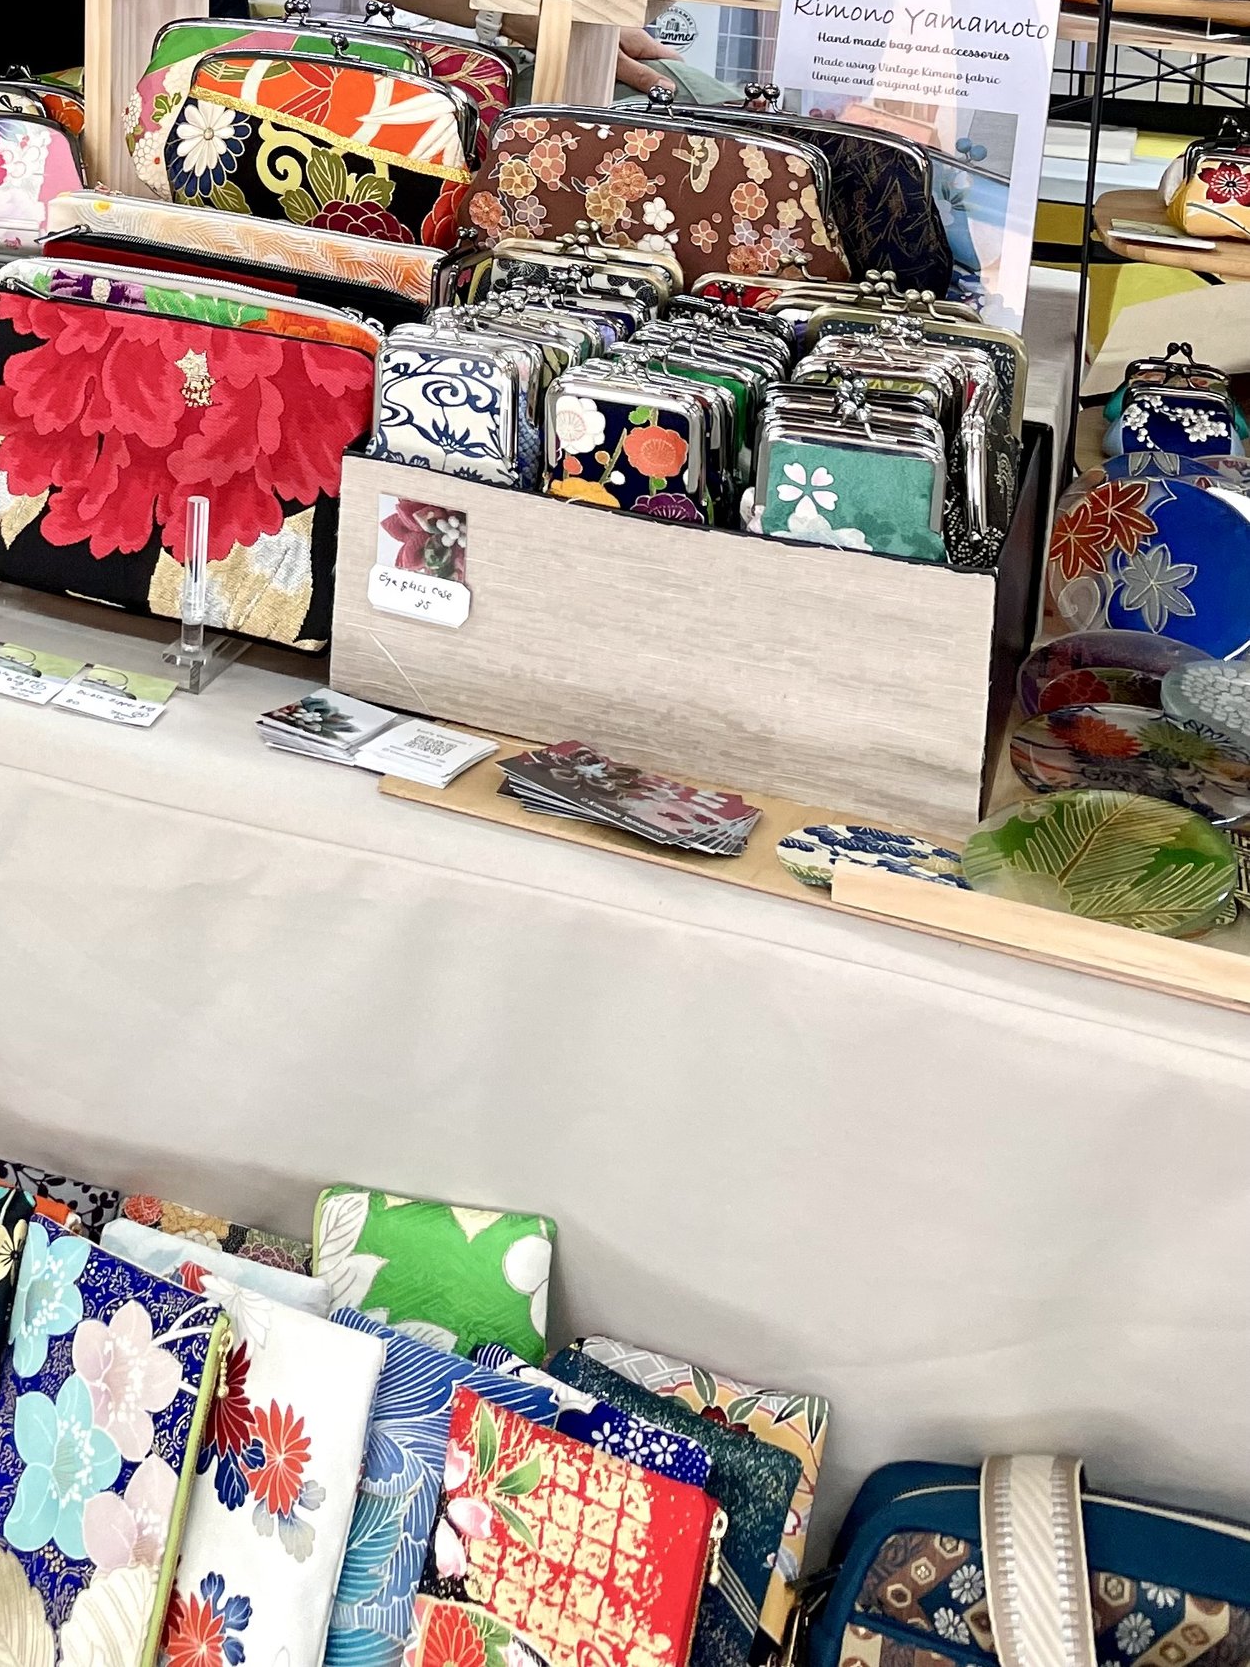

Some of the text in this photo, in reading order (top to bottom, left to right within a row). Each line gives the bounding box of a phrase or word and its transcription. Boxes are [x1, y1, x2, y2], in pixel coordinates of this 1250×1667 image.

[905, 7, 1049, 40] Yamamoto
[818, 32, 1010, 61] Hand made bag and accessories
[811, 71, 969, 98] Unique and original gift idea
[813, 55, 1001, 85] Made using Vintage Kimono fabric
[622, 816, 667, 838] Yamamoto
